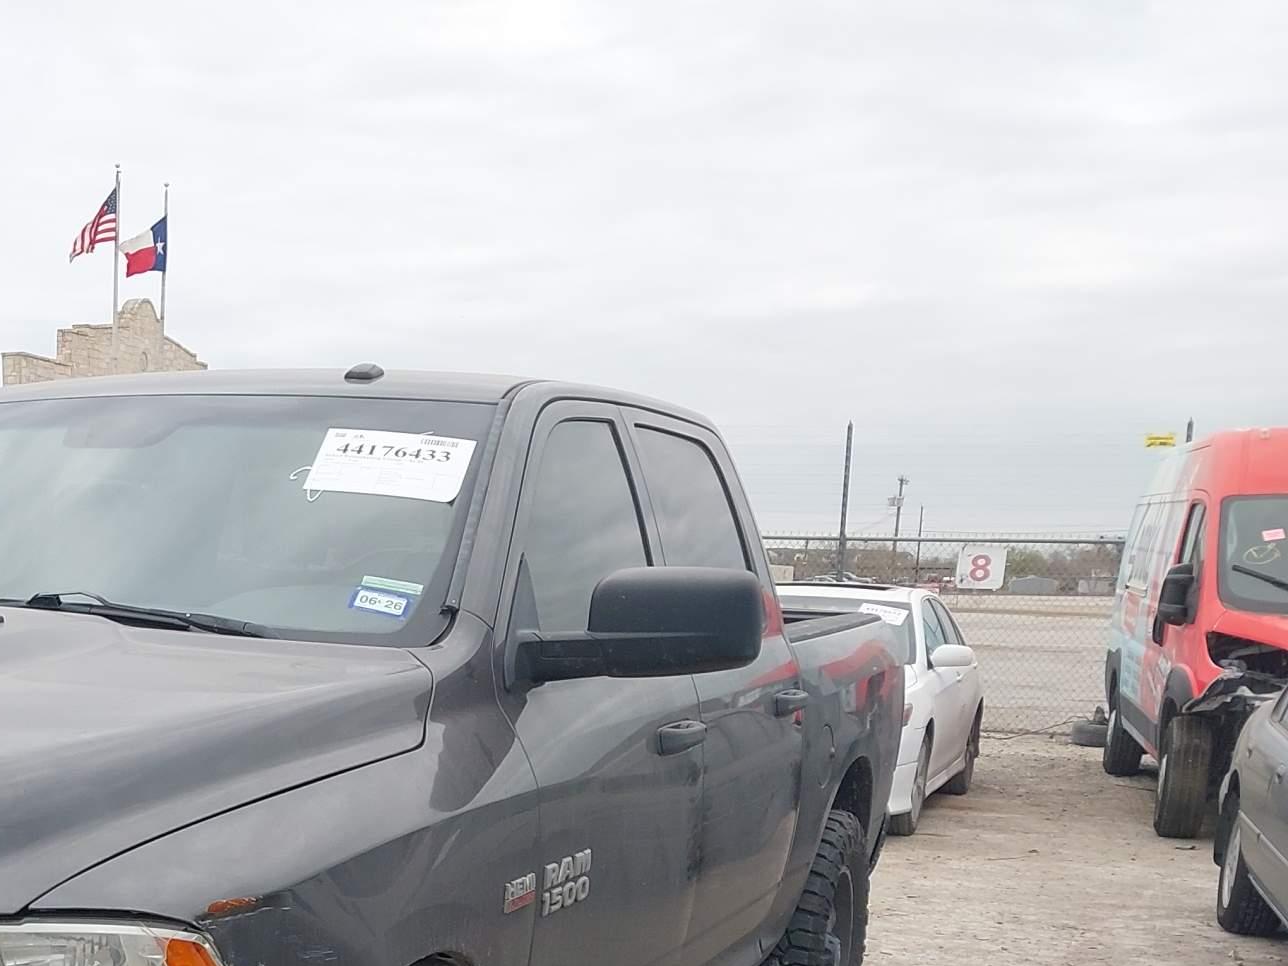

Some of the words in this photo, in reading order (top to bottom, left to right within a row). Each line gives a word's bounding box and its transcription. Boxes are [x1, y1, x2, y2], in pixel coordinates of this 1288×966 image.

[336, 442, 452, 463] 44176433
[969, 554, 992, 582] 8
[359, 594, 378, 606] 06
[384, 599, 404, 611] 26
[543, 848, 592, 889] RAM
[542, 875, 590, 917] 1500
